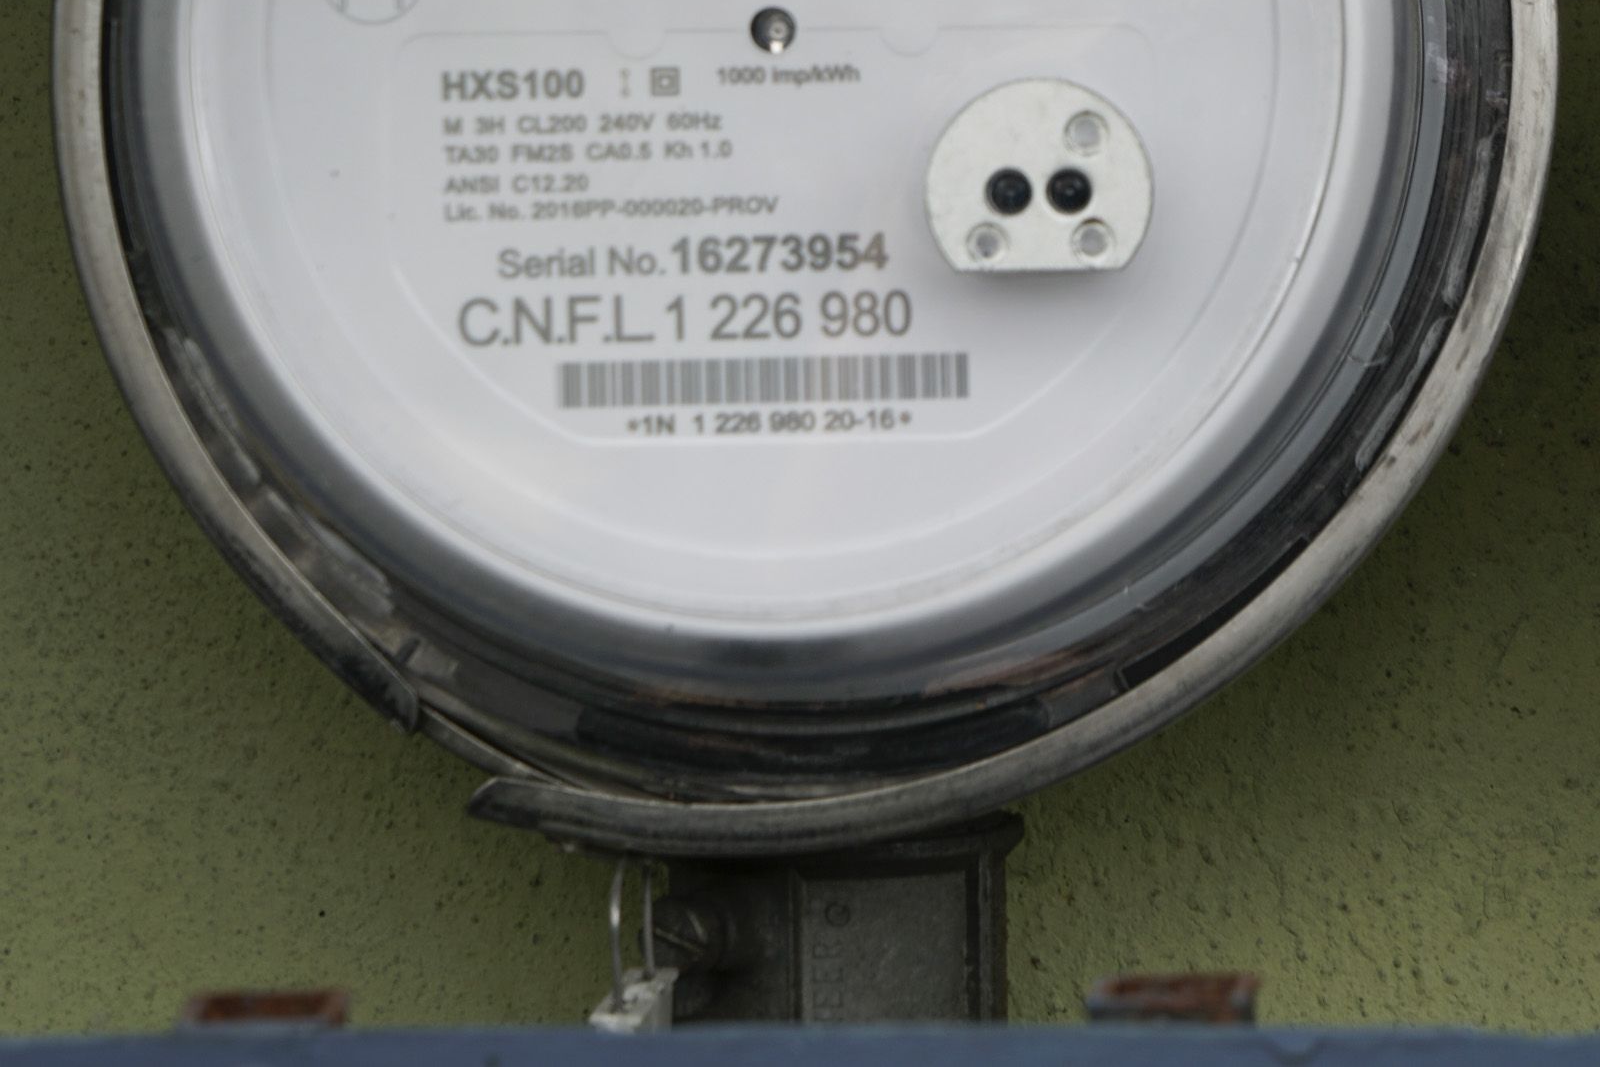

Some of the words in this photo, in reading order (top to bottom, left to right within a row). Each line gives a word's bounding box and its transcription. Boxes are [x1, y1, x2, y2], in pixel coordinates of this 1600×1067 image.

[442, 69, 585, 100] HXS100
[717, 66, 767, 85] 1000
[771, 65, 861, 88] imp/kWh
[517, 114, 588, 134] CL200
[599, 113, 655, 133] 240V
[666, 112, 723, 131] 60Hz
[444, 144, 499, 164] TA30
[511, 143, 574, 163] FM2S
[586, 141, 652, 161] CA0.5
[663, 141, 693, 159] Kh
[701, 139, 732, 158] 1.0
[443, 175, 499, 195] ANSI
[512, 174, 589, 193] C12.20
[444, 202, 483, 223] Lic.
[488, 201, 526, 221] No.
[497, 246, 596, 279] Serial
[607, 246, 667, 277] No.
[670, 232, 889, 273] 16273954
[666, 294, 687, 342] 1
[708, 291, 803, 340] 226
[819, 289, 912, 338] 980
[692, 414, 704, 434] 1
[714, 412, 762, 433] 226
[769, 410, 816, 432] 980
